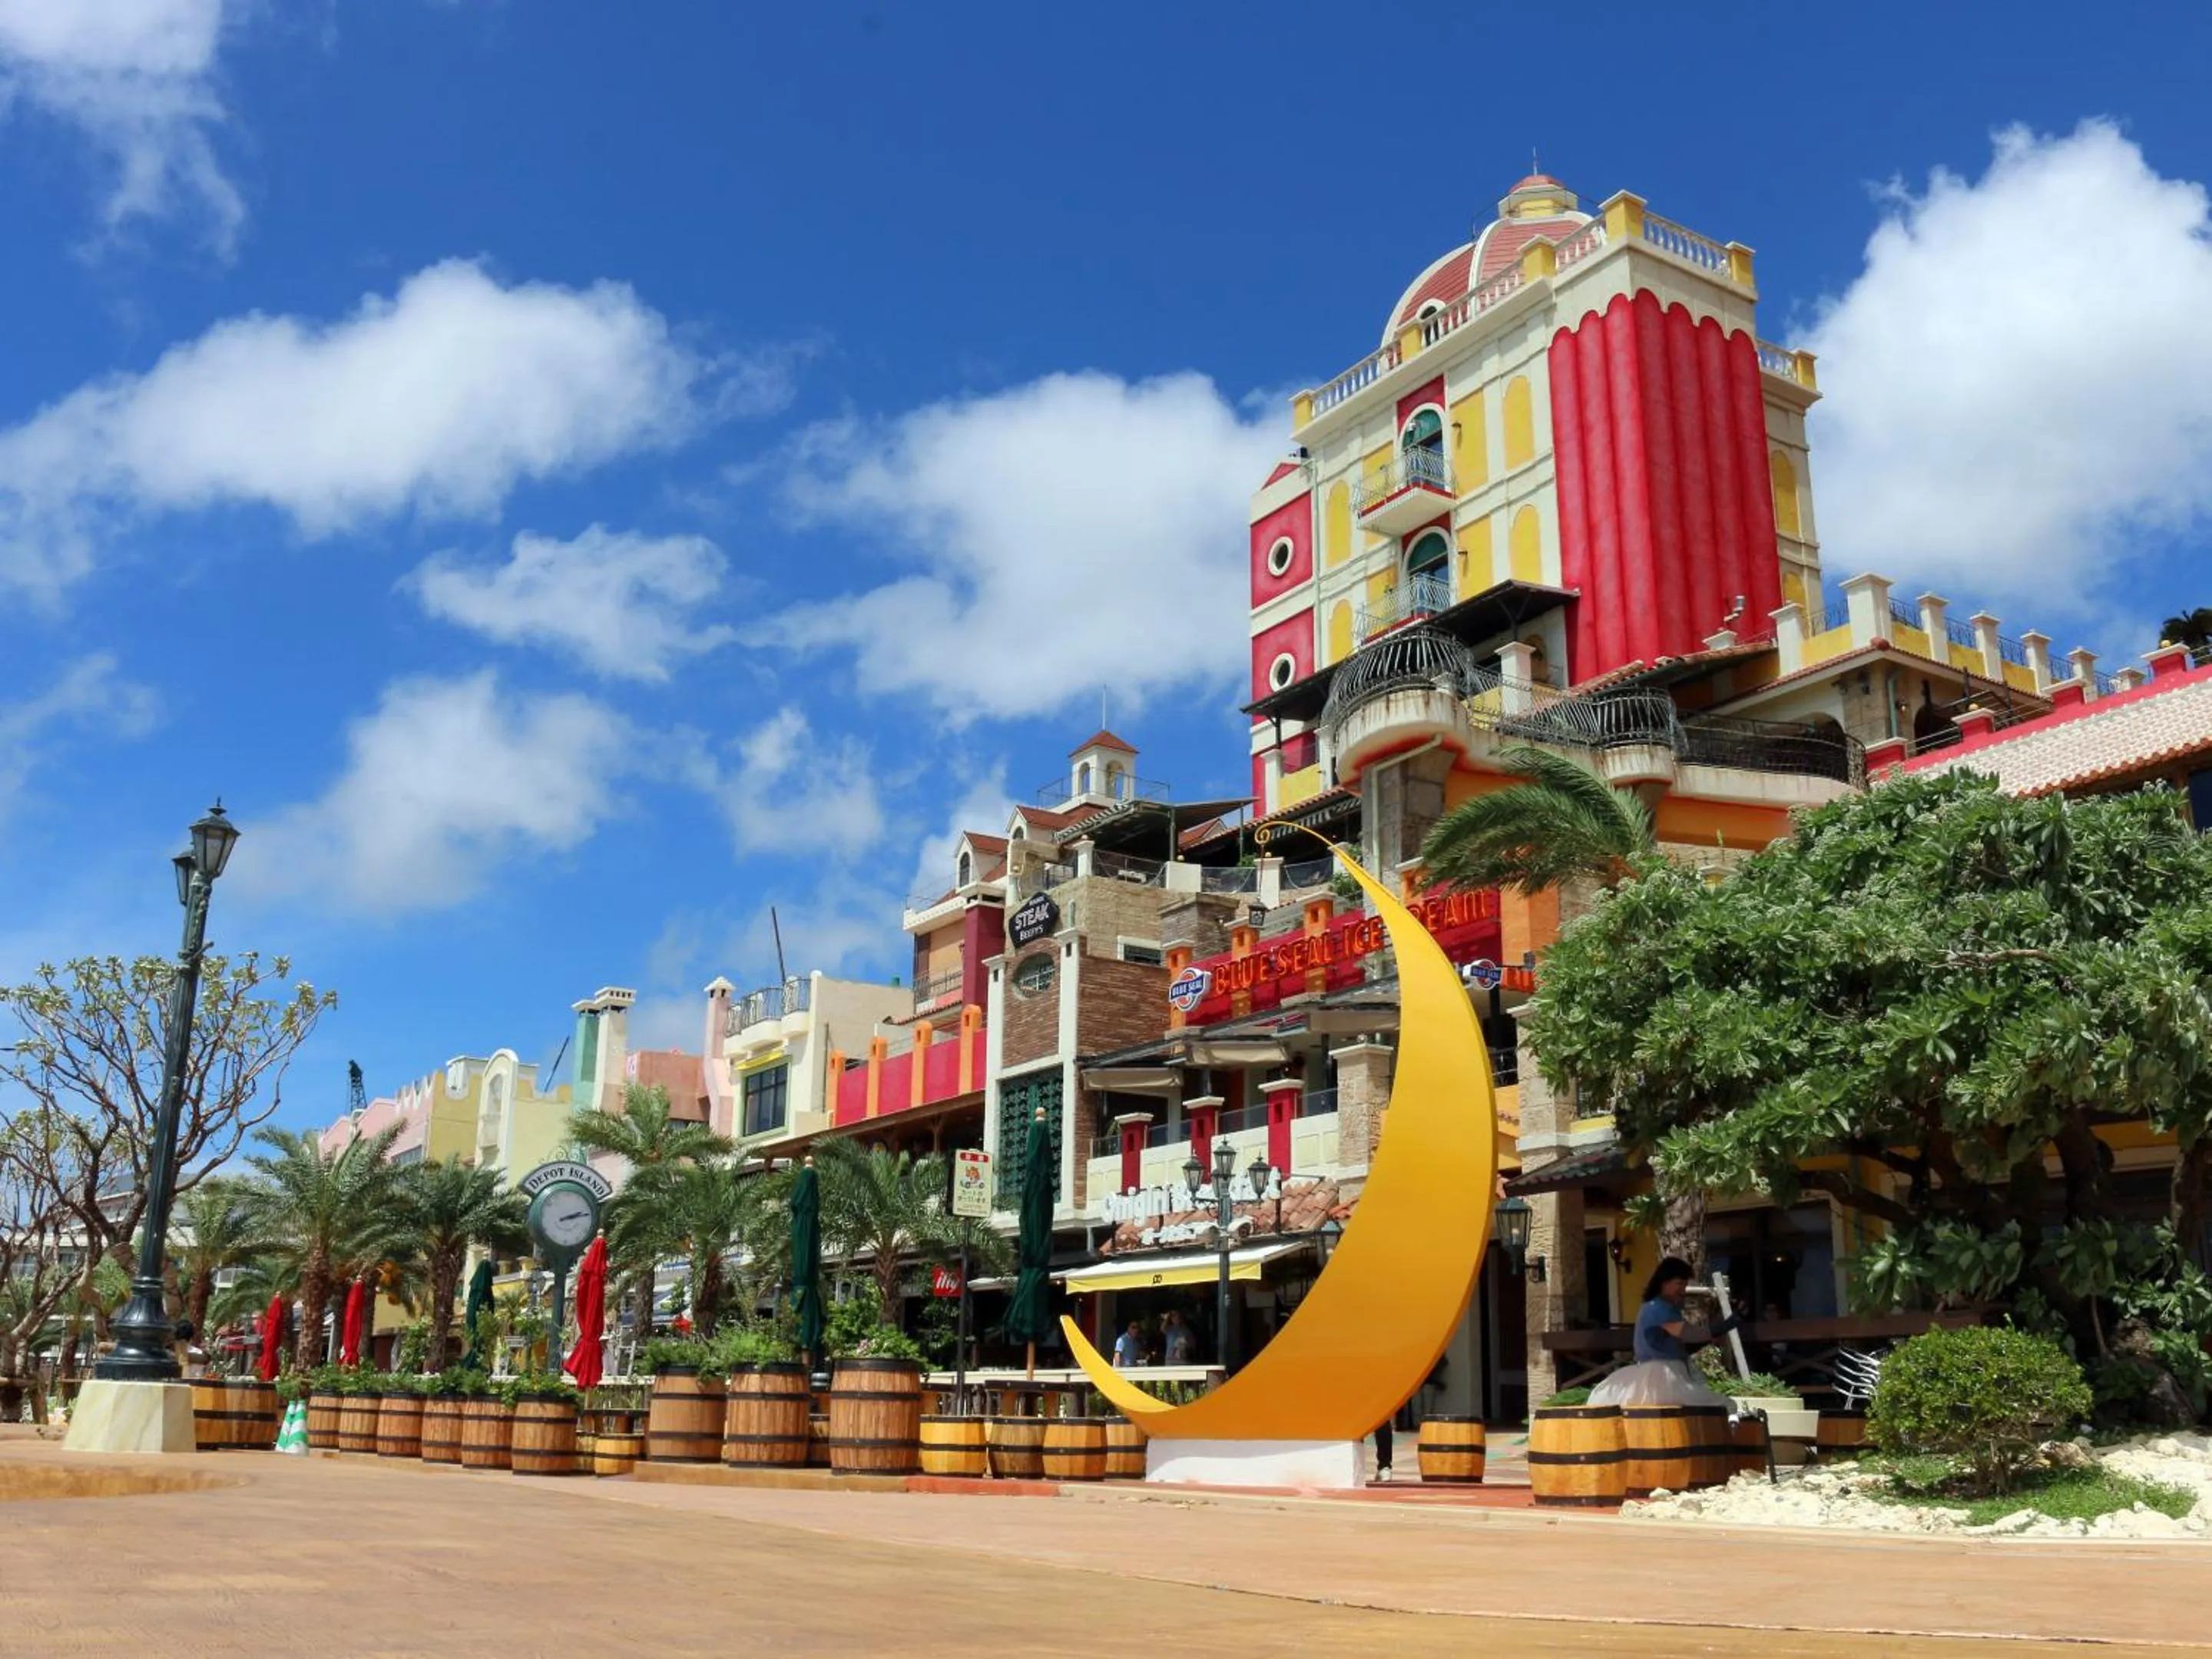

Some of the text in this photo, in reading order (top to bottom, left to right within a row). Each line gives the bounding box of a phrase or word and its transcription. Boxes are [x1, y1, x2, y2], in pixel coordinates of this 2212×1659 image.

[1015, 902, 1049, 930] STEAK
[1214, 889, 1486, 997] BLUE SEAL ICE EAM
[528, 1167, 604, 1196] DEPOT ISLAND
